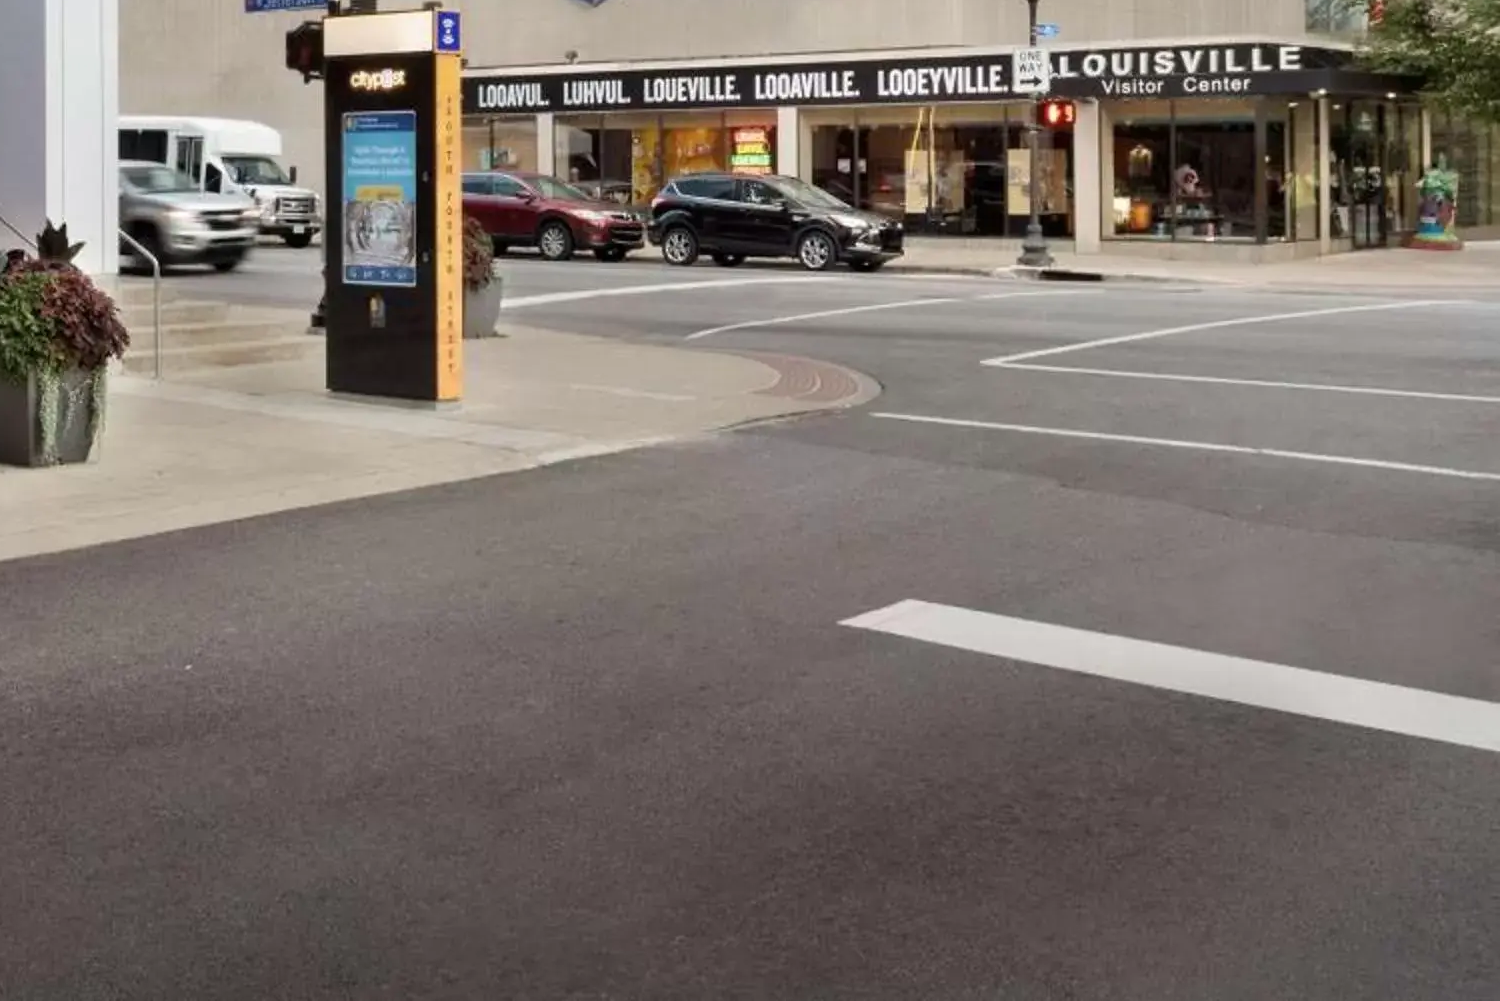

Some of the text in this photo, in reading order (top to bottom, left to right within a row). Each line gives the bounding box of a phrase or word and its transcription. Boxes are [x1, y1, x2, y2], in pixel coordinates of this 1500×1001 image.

[1019, 51, 1042, 62] ONE
[1060, 46, 1302, 78] LOUISVILLE
[1018, 62, 1043, 73] WAY
[563, 79, 631, 106] LUHVUL.
[643, 75, 741, 103] LOUEVILLE.
[754, 70, 861, 100] LOOAVILLE.
[877, 64, 1009, 97] LOOEYVILLE.
[1102, 76, 1252, 95] Visitor Center
